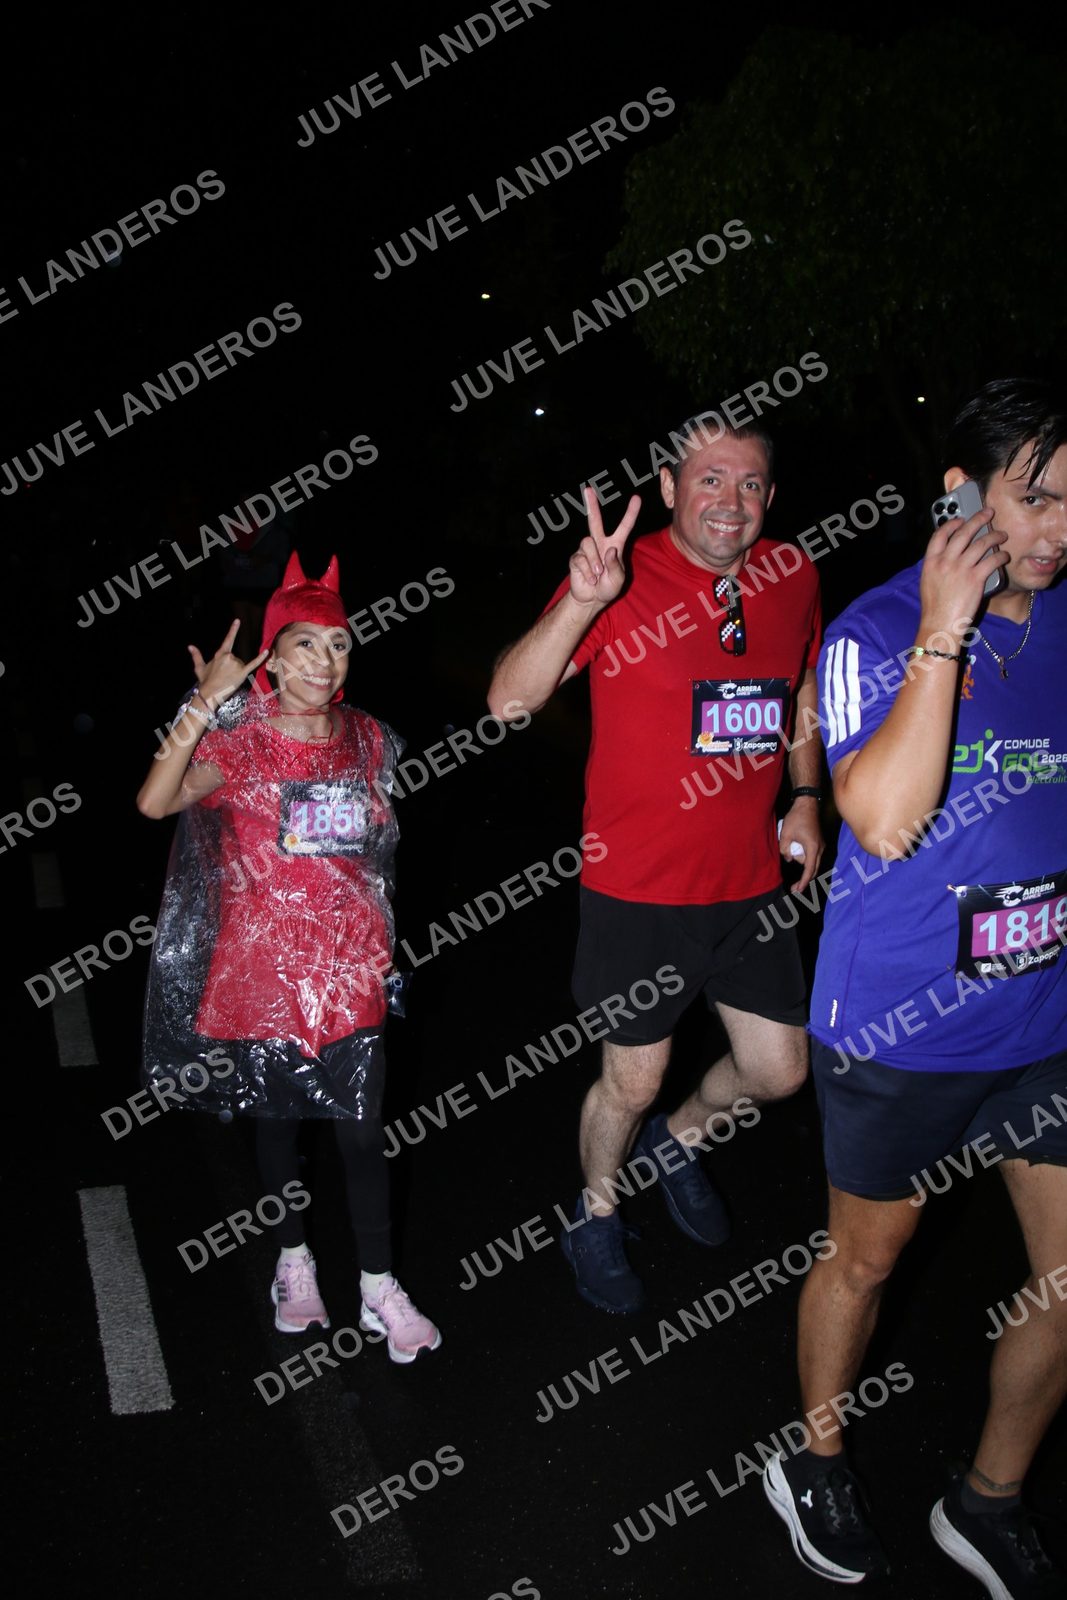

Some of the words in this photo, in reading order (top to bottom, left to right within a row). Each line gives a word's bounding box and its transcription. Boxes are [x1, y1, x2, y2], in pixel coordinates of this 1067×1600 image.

[706, 701, 781, 734] 1600
[743, 741, 777, 752] Zapopan
[1004, 738, 1050, 750] COMUDE
[1041, 753, 1067, 764] 2026
